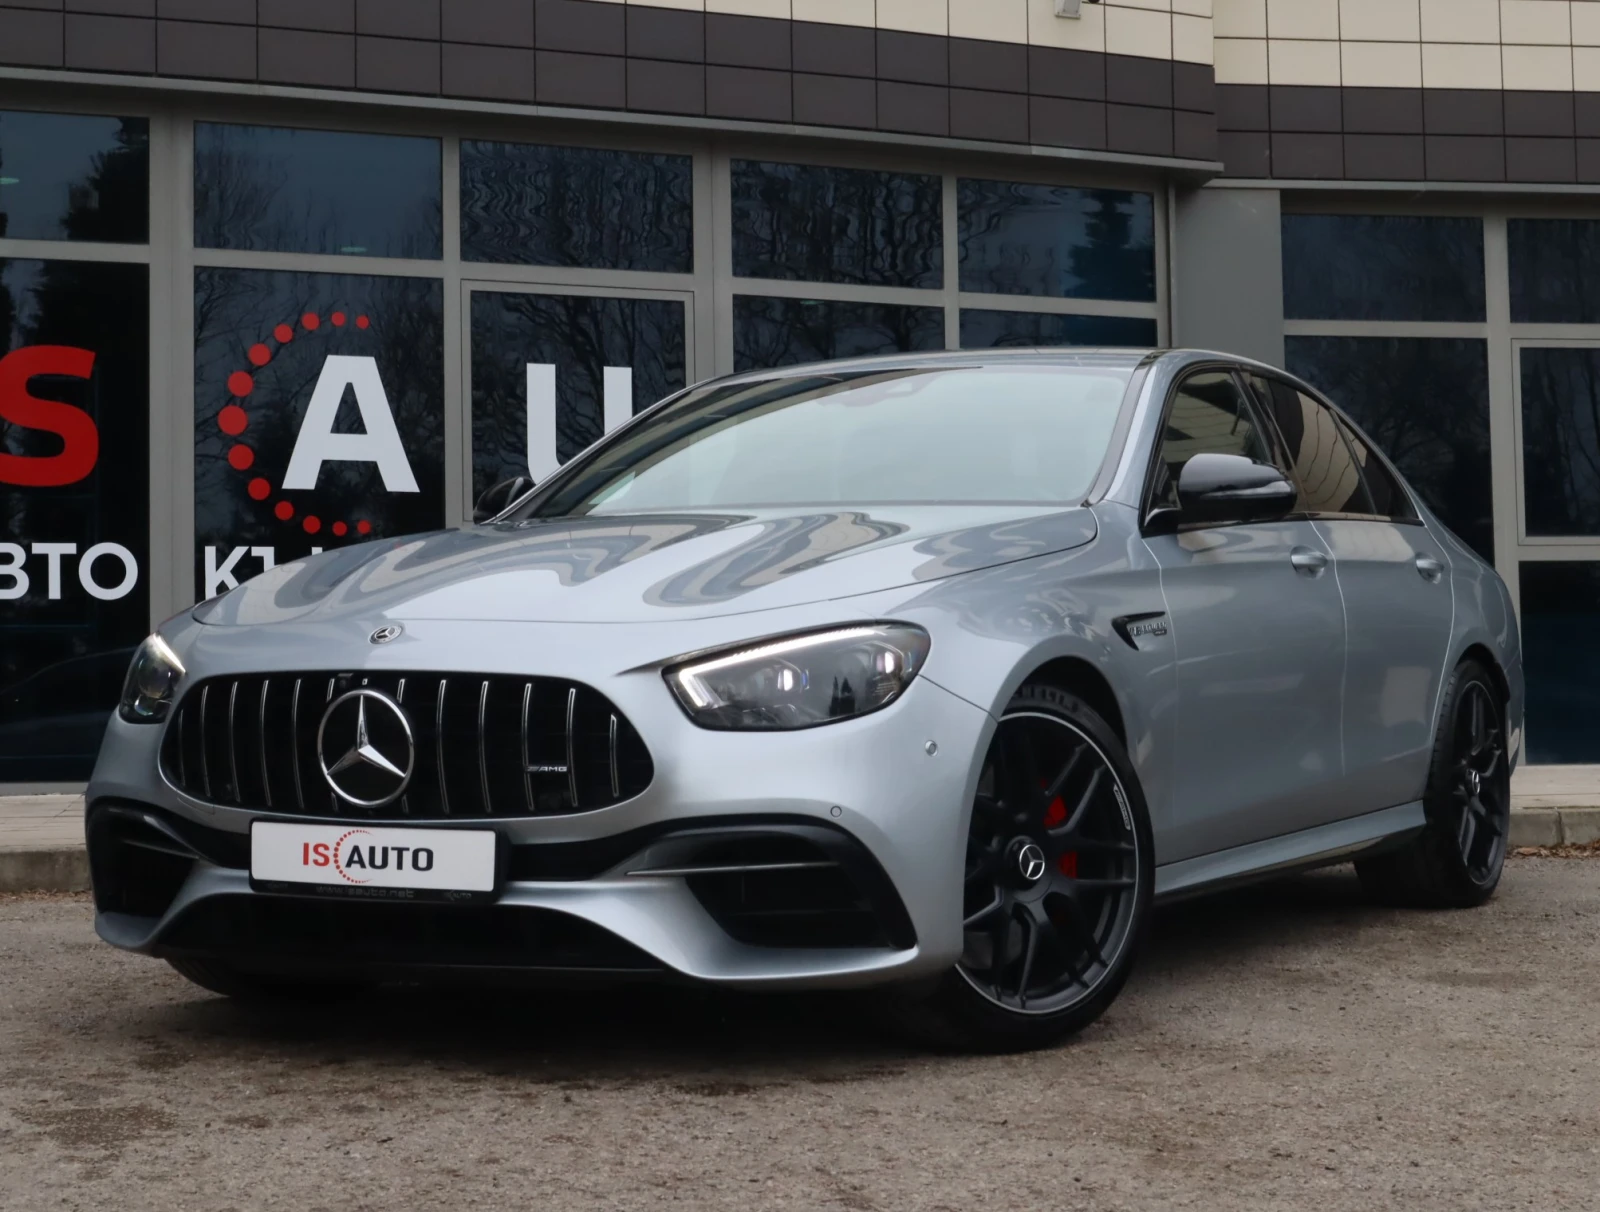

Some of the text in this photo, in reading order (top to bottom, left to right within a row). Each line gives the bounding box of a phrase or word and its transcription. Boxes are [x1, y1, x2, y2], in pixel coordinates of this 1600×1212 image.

[538, 765, 568, 773] AMG
[302, 842, 434, 872] IS AUTO
